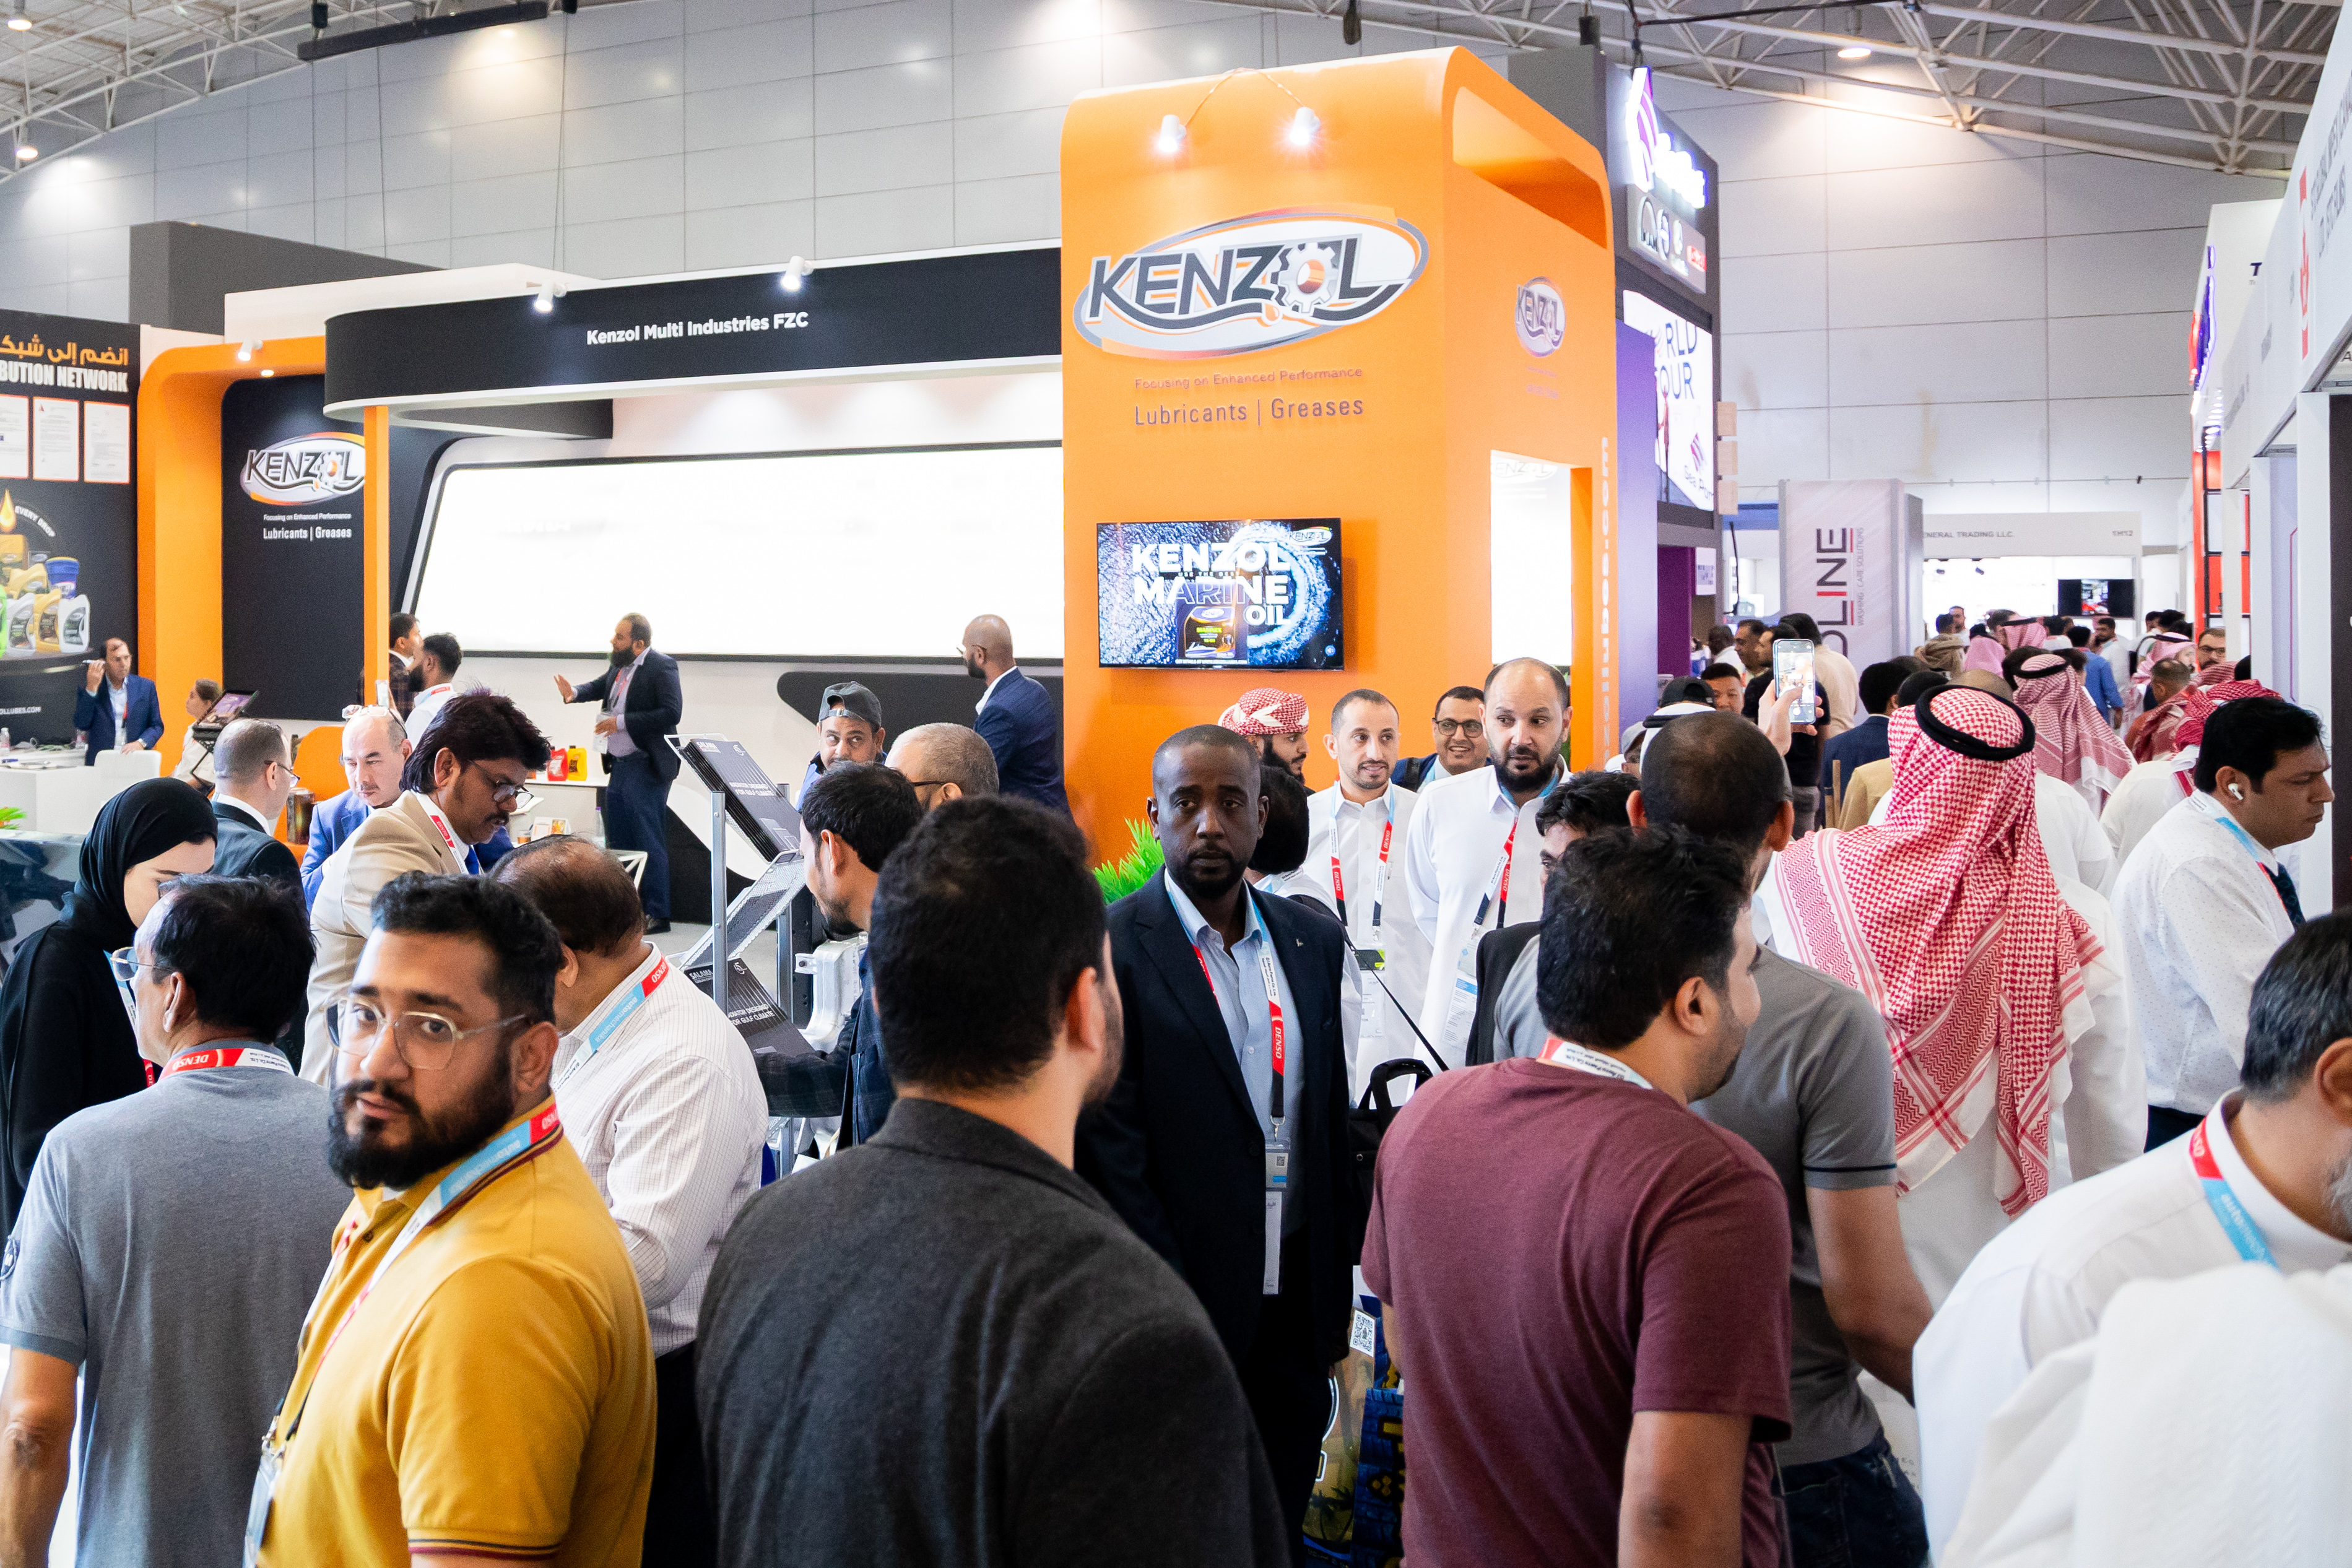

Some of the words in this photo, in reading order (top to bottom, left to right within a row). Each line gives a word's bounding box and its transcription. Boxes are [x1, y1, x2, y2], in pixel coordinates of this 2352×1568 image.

[1085, 233, 1404, 328] KENZOL
[587, 326, 640, 345] Kenzol
[644, 321, 683, 340] Multi
[687, 315, 769, 336] Industries
[773, 311, 809, 329] FZC
[47, 342, 77, 366] إلى
[80, 346, 129, 366] انضم
[57, 366, 129, 392] NETWORK
[1135, 376, 1190, 390] Focusing
[1194, 376, 1209, 386] on
[1213, 371, 1275, 385] Enhanced
[1279, 367, 1363, 381] Performance
[1654, 362, 1695, 400] OUR
[1135, 403, 1248, 426] Lubricants
[1271, 397, 1364, 420] Greases
[245, 449, 363, 488] KENZOL
[14, 505, 38, 522] EVERY
[37, 518, 56, 537] DROP
[264, 514, 286, 522] Focusing
[263, 527, 308, 540] Lubricants
[315, 526, 352, 538] Greases
[1132, 542, 1290, 573] KENZOL
[1133, 574, 1289, 605] MARINE
[1244, 605, 1291, 626] OIL
[651, 961, 666, 982] DENSO
[593, 996, 640, 1043] automechanika
[728, 1009, 747, 1018] DIATOR
[740, 1015, 753, 1024] GULF
[753, 1011, 775, 1021] CLIMATE
[1274, 1026, 1282, 1060] DENSO
[171, 1054, 209, 1070] DENSO
